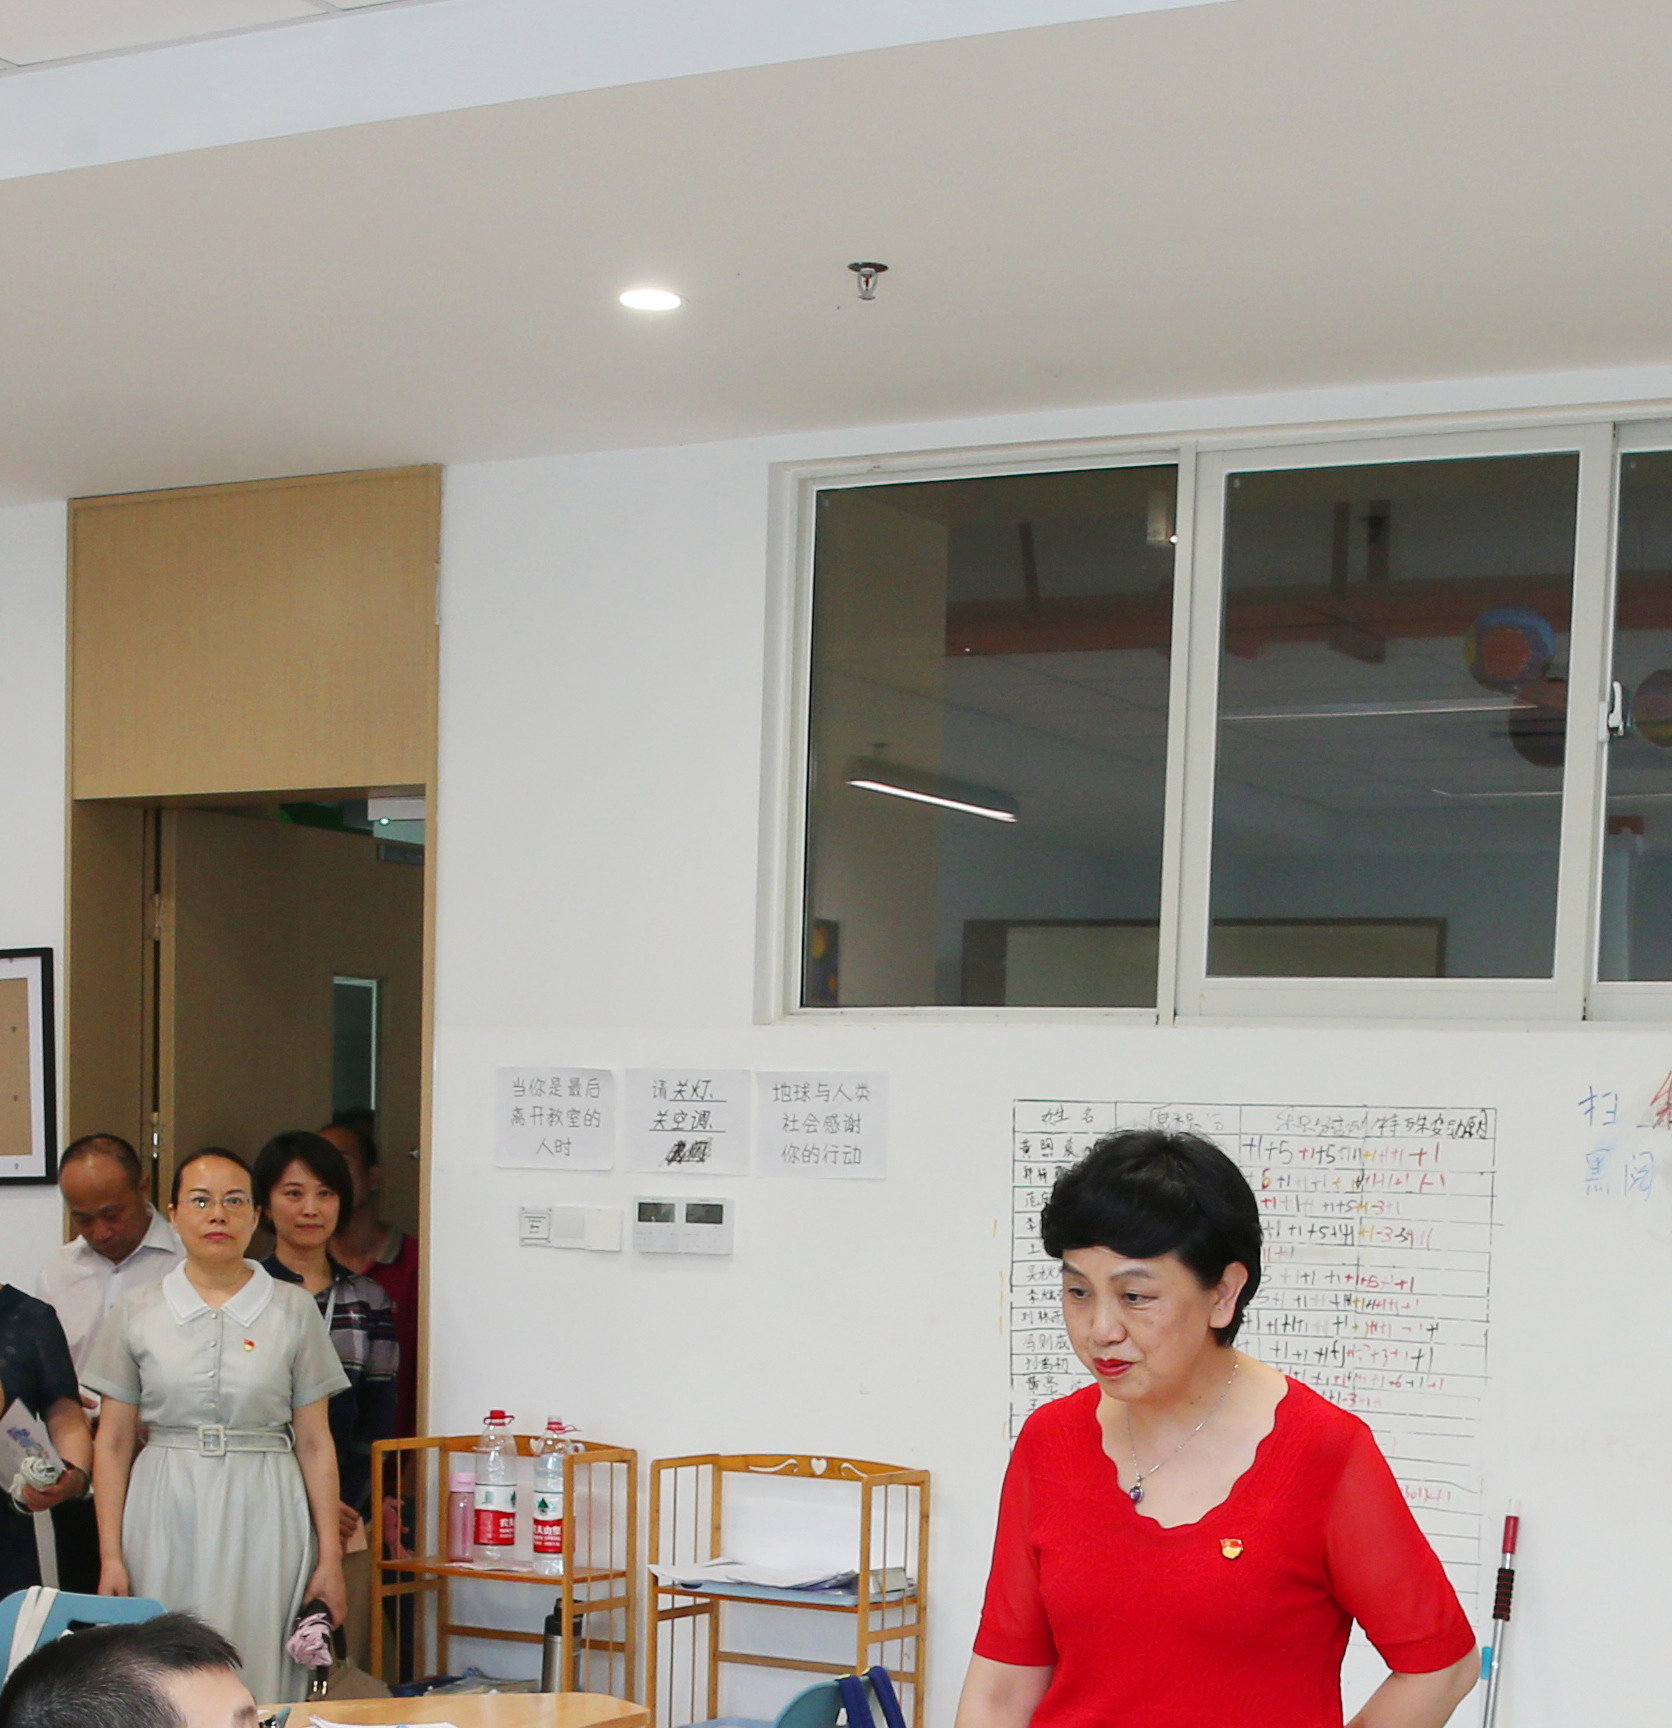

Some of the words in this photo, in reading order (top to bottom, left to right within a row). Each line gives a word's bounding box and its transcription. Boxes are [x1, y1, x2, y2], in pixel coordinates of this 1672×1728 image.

[512, 1076, 600, 1098] 当你是最后
[772, 1082, 871, 1103] 地球与人类
[511, 1106, 601, 1128] 离开教室的
[781, 1112, 861, 1134] 社会感谢
[535, 1137, 572, 1157] 人时
[781, 1143, 862, 1165] 你的行动
